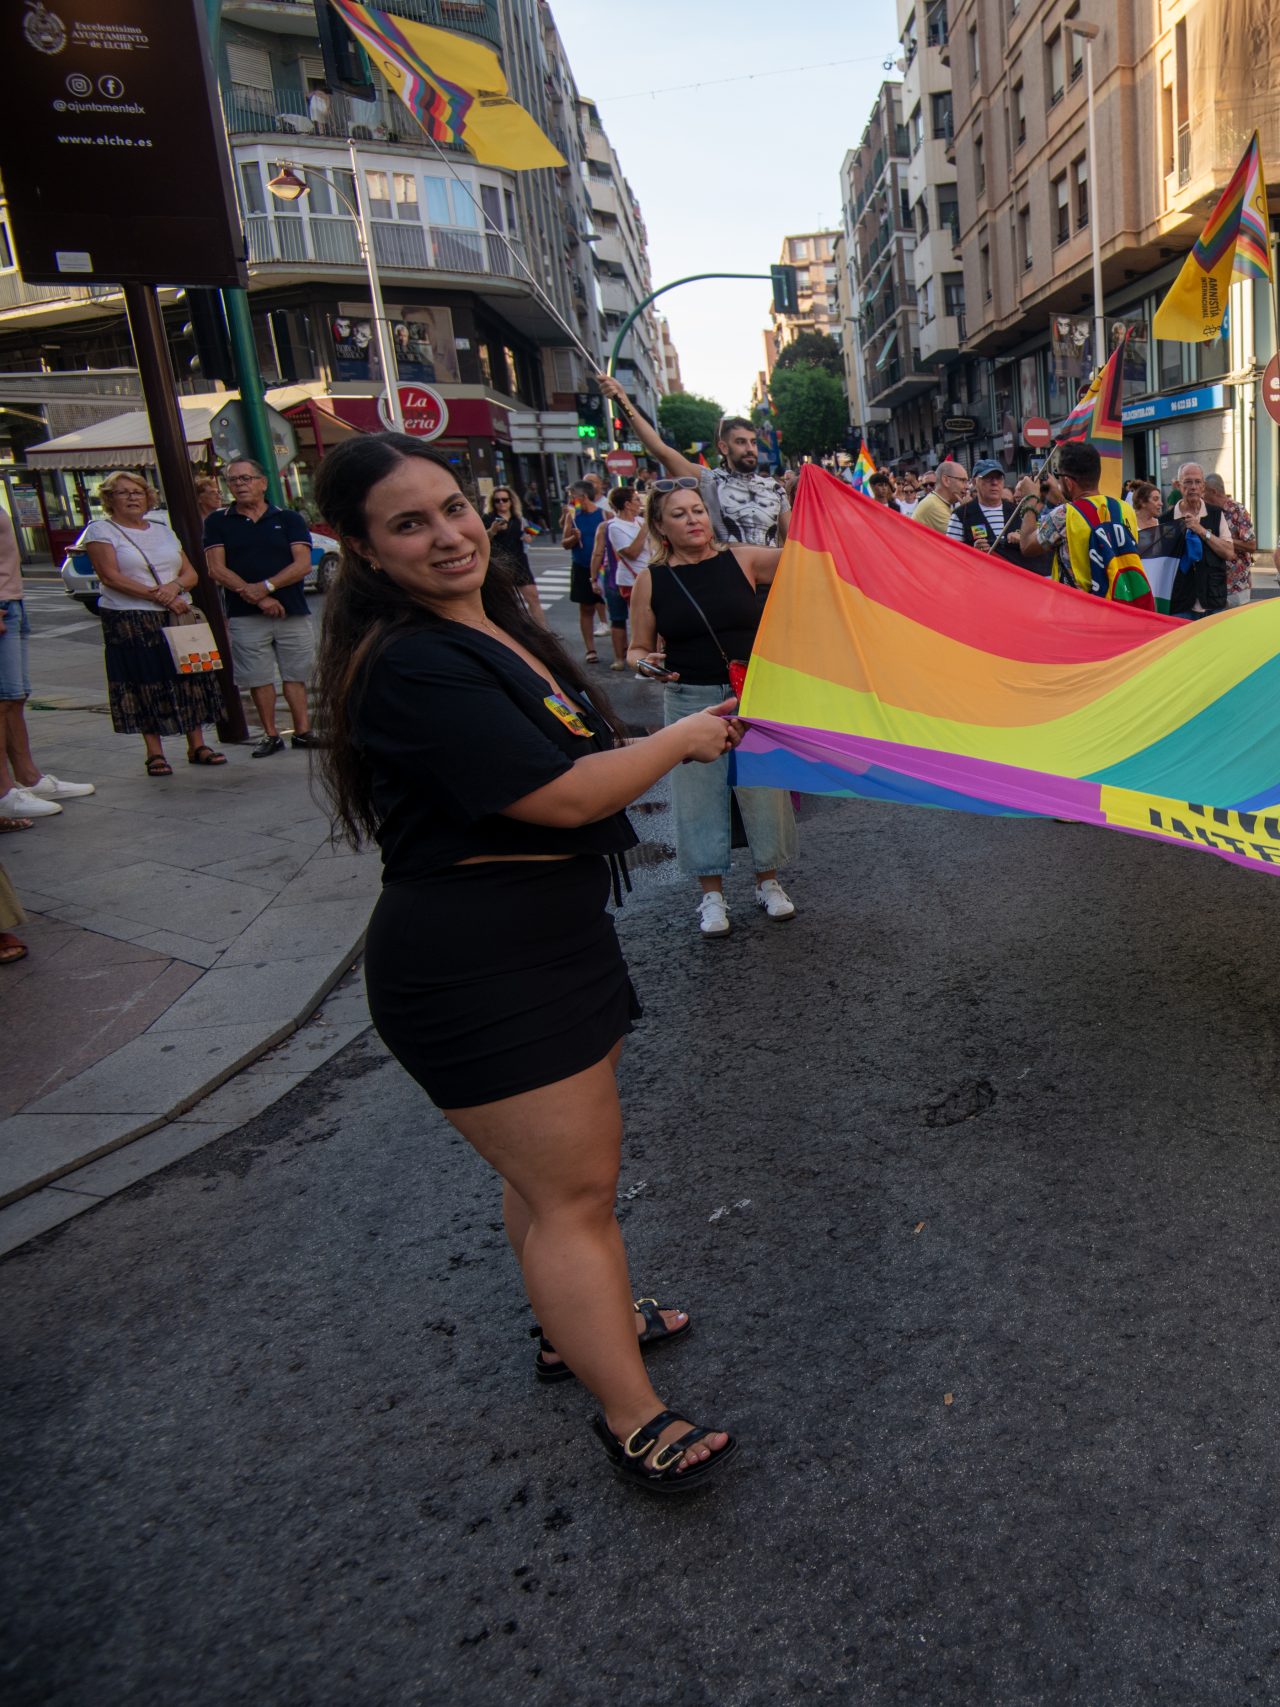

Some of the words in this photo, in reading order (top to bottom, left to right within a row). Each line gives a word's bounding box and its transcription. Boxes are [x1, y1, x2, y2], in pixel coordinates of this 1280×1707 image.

[72, 31, 149, 43] AYUNTAMIENTO
[104, 42, 134, 50] ELCHE
[53, 99, 145, 114] @ajuntamentelx
[58, 135, 153, 147] www.elche.es
[1208, 277, 1221, 318] AMNISTÍA
[405, 392, 428, 408] La
